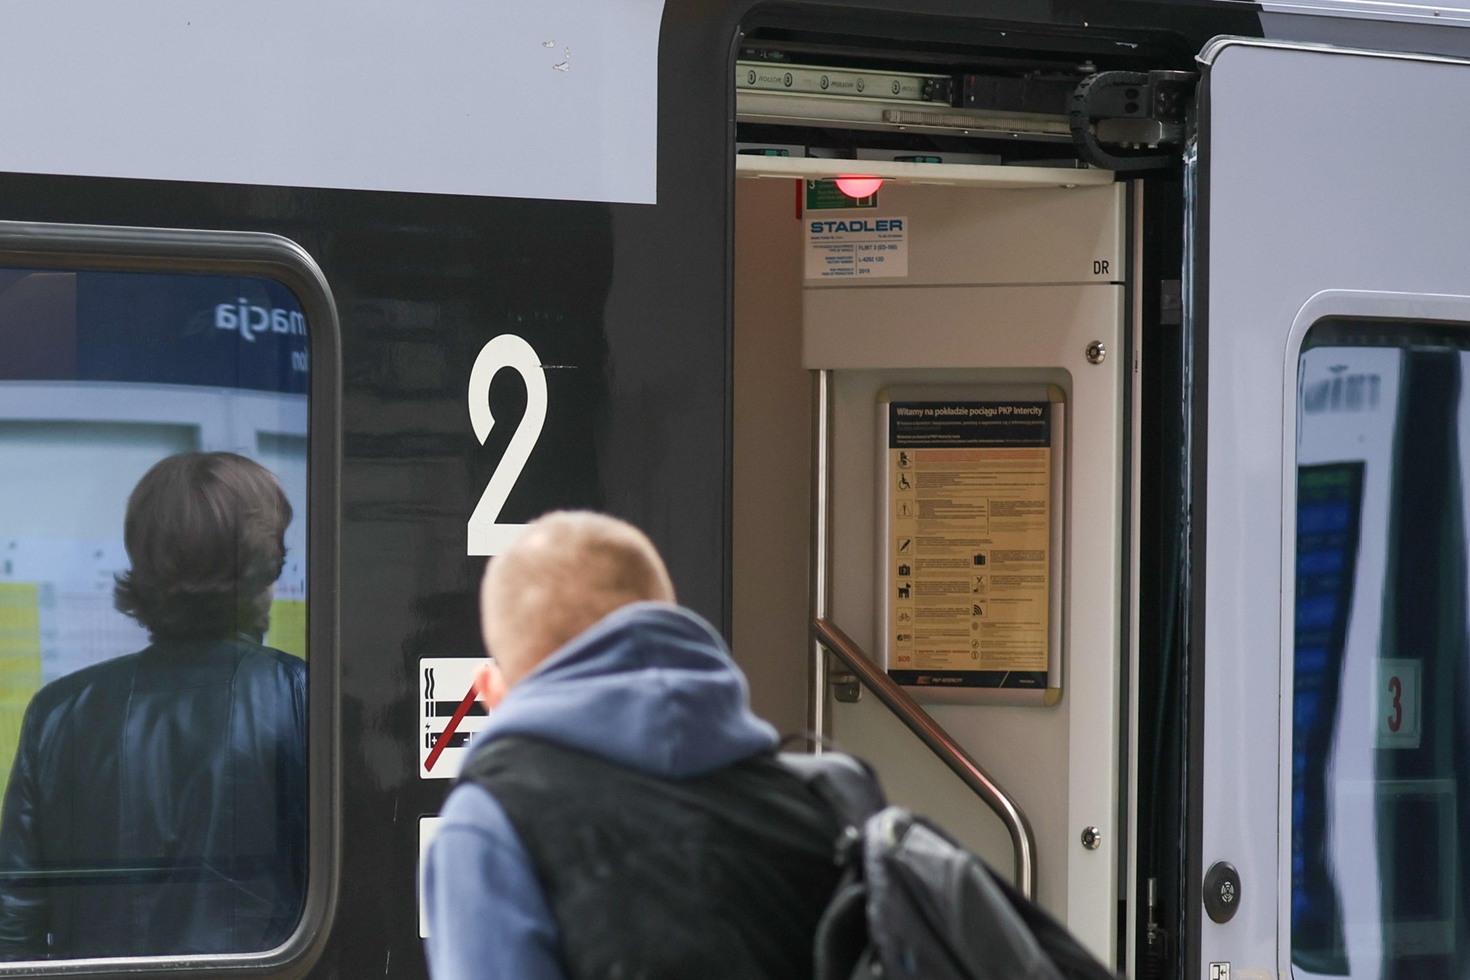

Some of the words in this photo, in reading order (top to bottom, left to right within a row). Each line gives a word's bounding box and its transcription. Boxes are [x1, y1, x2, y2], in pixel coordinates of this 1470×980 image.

[810, 219, 903, 233] STADLER
[1093, 260, 1109, 275] DR
[896, 407, 923, 418] Witamy
[998, 406, 1013, 415] PKP
[1013, 406, 1043, 417] Intercity
[467, 333, 549, 556] 2
[1387, 675, 1402, 734] 3
